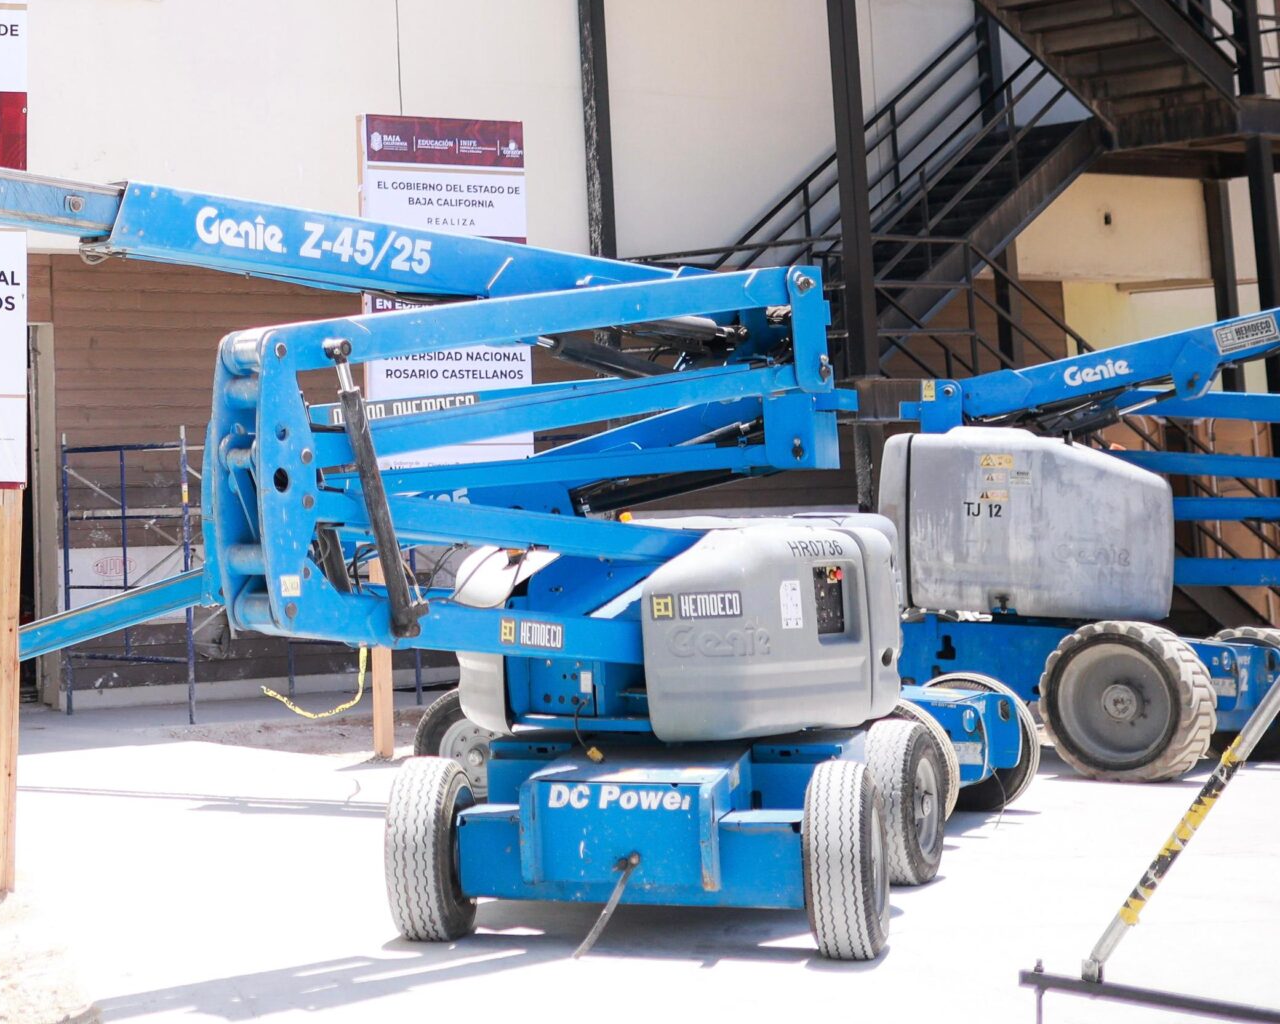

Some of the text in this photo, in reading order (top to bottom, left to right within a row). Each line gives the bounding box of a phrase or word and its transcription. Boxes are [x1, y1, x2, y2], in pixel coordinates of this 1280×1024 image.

[377, 181, 520, 195] EL GOBIERNO DEL ESTADO DE
[408, 197, 495, 208] BAJA CALIFORNIA
[427, 217, 476, 226] REALIZA
[195, 206, 432, 274] Genie Z-45/25
[376, 298, 392, 310] EN
[466, 351, 526, 362] NACIONAL
[385, 368, 524, 379] ROSARIO CASTELLANOS
[1063, 358, 1130, 386] Genie
[963, 501, 1002, 518] TJ 12
[787, 540, 844, 557] HR0736
[680, 592, 741, 617] HEMOECO
[520, 621, 562, 648] HEMOECO
[548, 784, 691, 810] DC Power
